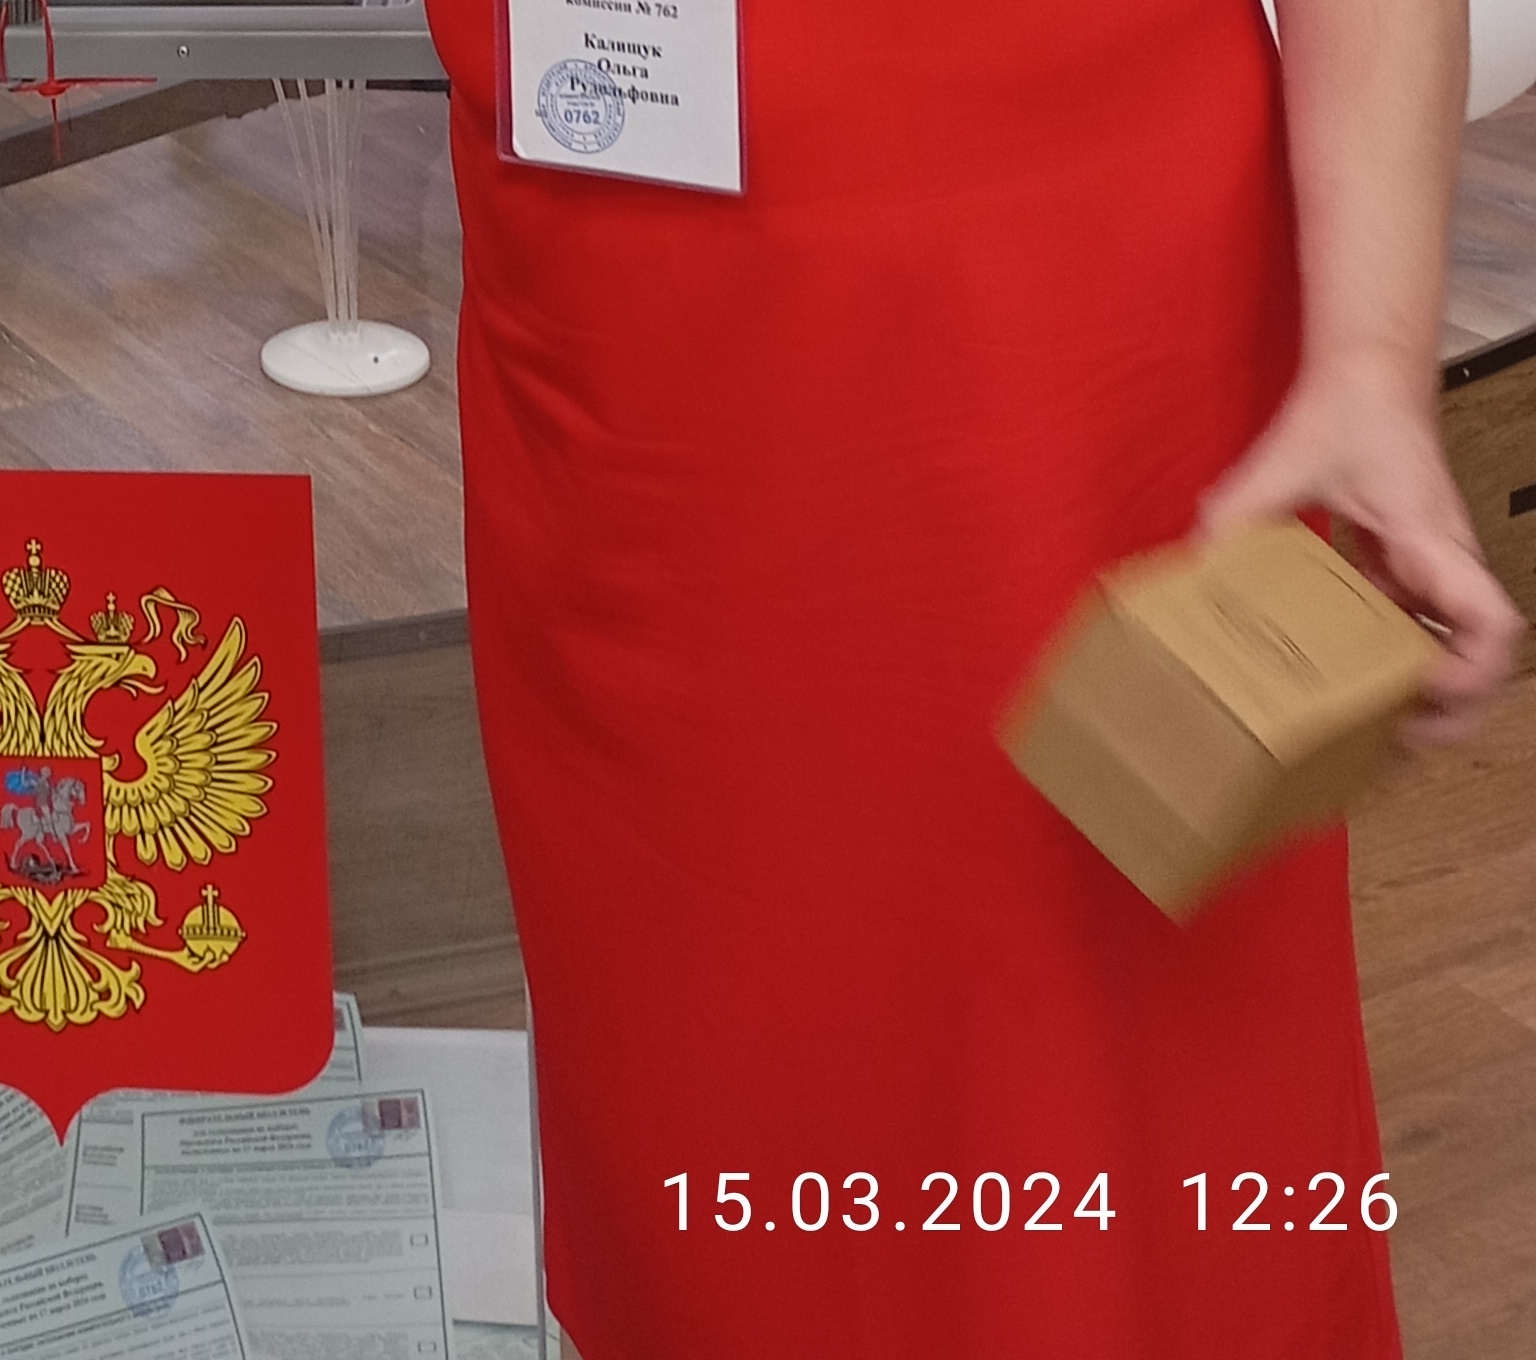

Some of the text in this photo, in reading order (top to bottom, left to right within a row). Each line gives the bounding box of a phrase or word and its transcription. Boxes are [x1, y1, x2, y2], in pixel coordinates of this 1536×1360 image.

[635, 0, 651, 16] №
[654, 2, 679, 20] 762
[584, 32, 662, 60] Калищук
[597, 57, 649, 79] Ольга
[564, 109, 601, 125] 0762
